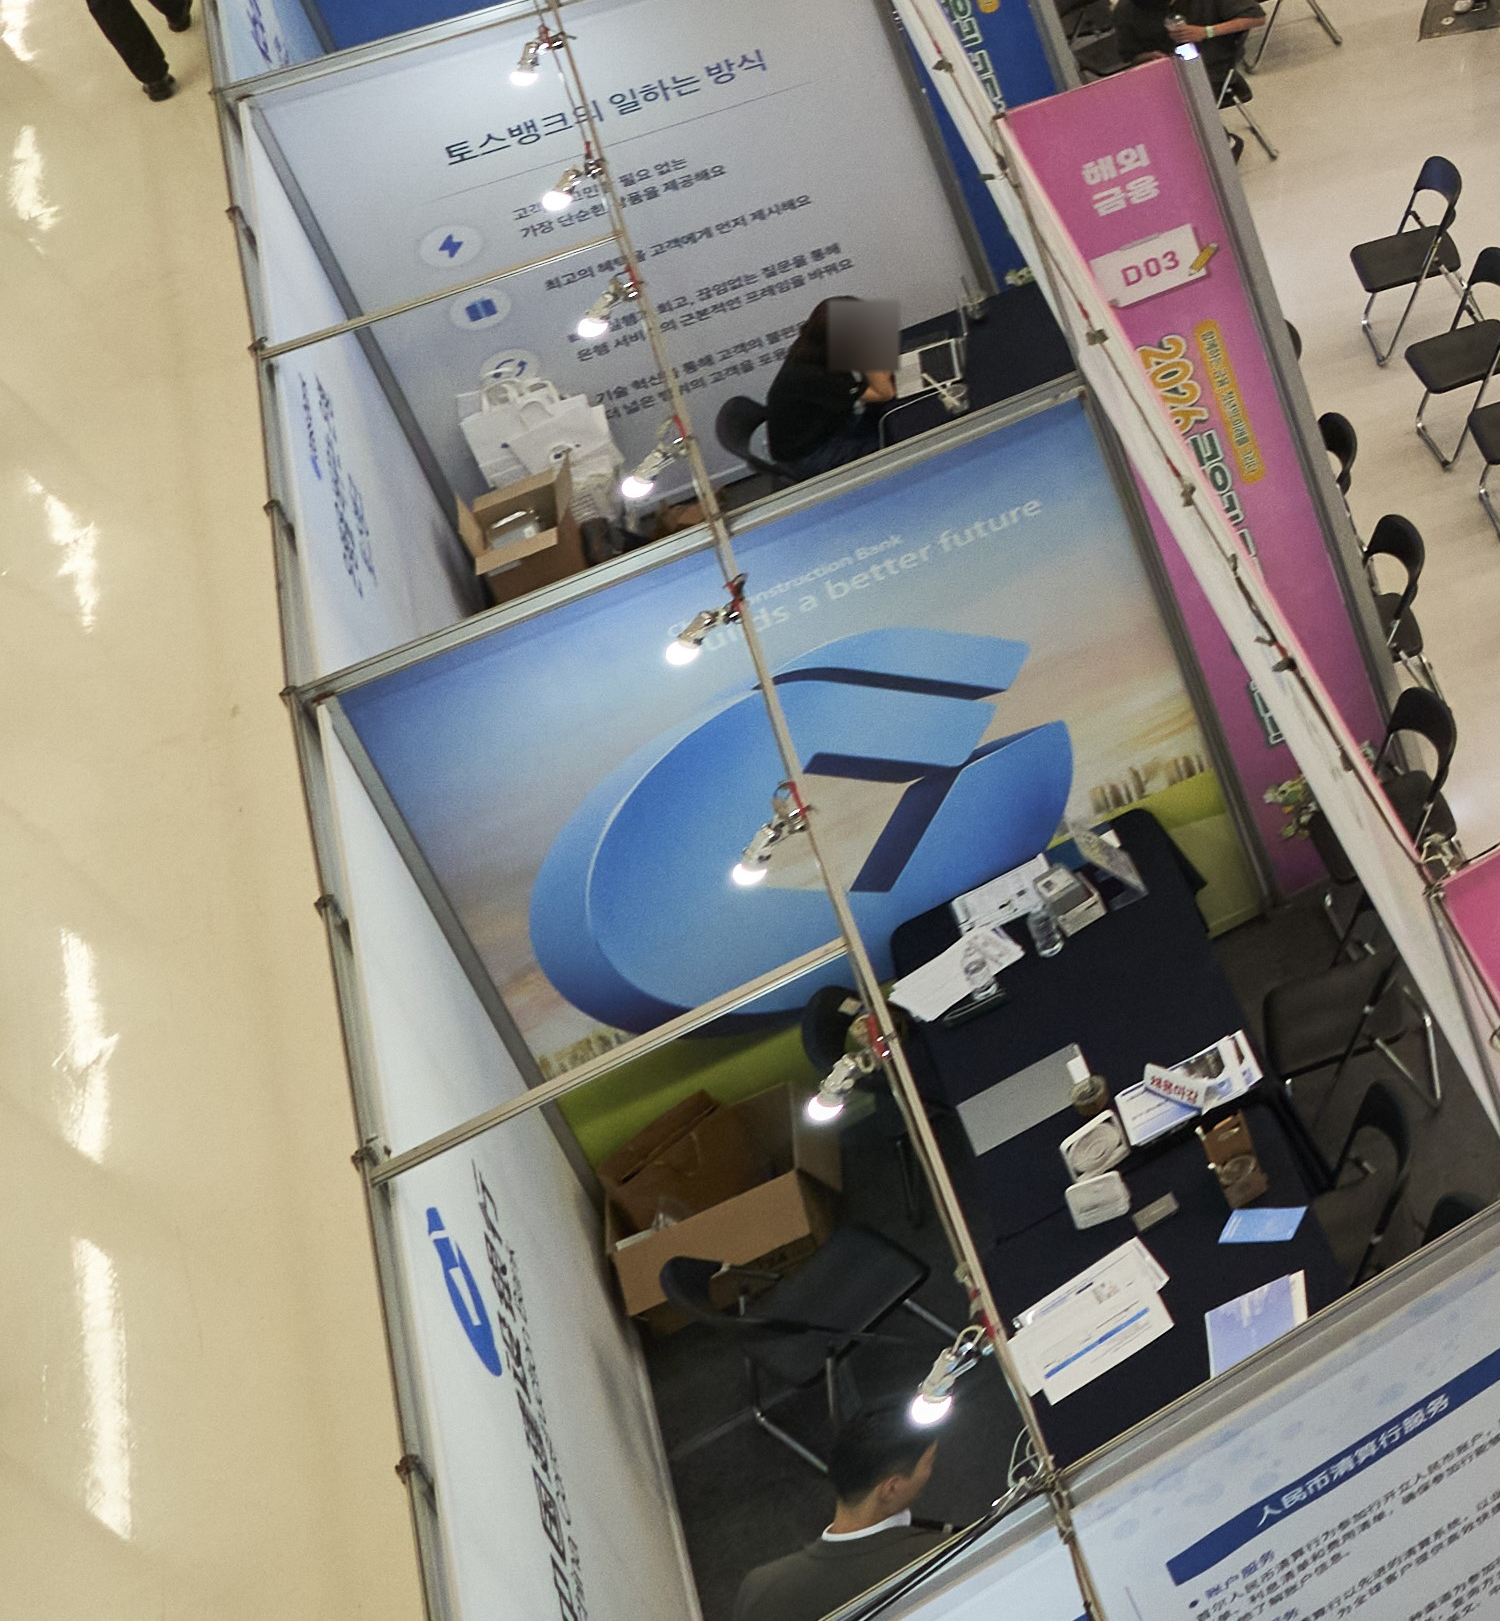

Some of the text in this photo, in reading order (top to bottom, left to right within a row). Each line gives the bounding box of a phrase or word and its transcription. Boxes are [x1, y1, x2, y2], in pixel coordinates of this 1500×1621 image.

[610, 77, 701, 118] 일하는
[705, 49, 767, 84] 방식
[1081, 144, 1151, 185] 해외
[1092, 175, 1160, 216] 금융
[1121, 250, 1180, 287] D03
[826, 498, 1043, 600] better future
[1256, 1392, 1450, 1527] 人民币清算行服务
